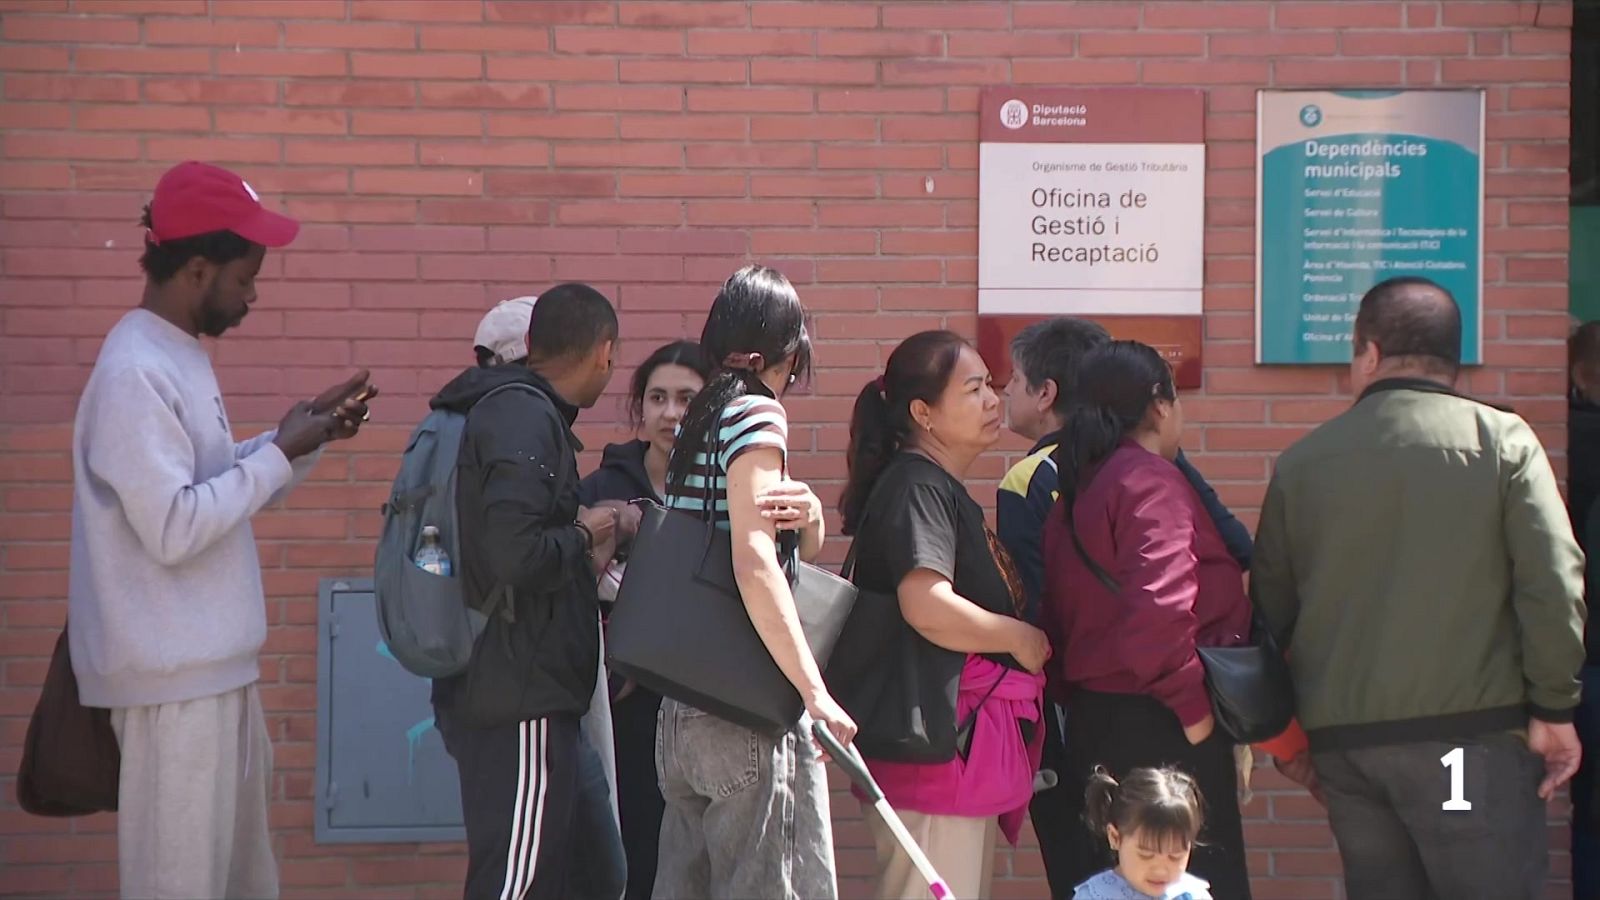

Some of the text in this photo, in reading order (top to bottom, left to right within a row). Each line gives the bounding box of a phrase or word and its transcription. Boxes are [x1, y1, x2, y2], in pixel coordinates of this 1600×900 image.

[1033, 104, 1087, 116] Diputació
[1033, 116, 1087, 126] Barcelona
[1305, 140, 1427, 159] Dependències
[1032, 161, 1086, 174] Organisme
[1089, 161, 1102, 172] de
[1105, 161, 1138, 172] Gestió
[1305, 161, 1401, 180] municipals
[1031, 187, 1148, 209] Oficina de
[1031, 215, 1120, 235] Gestió i
[1032, 243, 1160, 266] Recaptació
